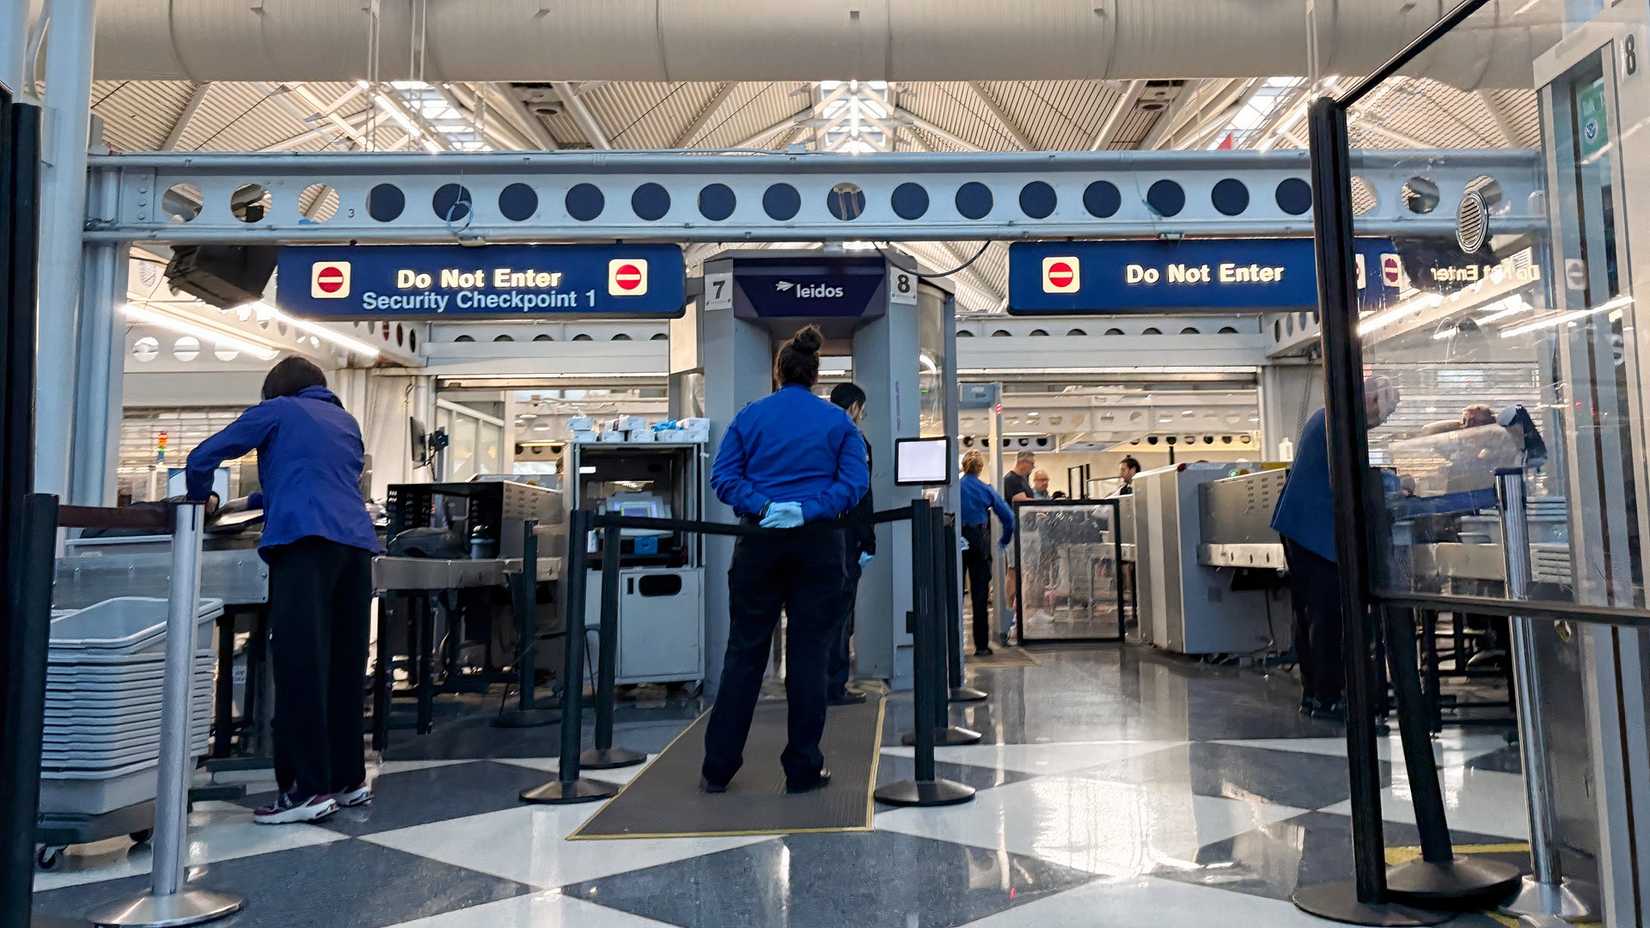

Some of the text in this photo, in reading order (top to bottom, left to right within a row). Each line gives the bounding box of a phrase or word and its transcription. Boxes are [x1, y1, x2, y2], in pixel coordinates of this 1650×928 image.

[1625, 34, 1636, 75] 8
[348, 208, 354, 218] 3
[398, 268, 561, 289] Do Not Enter
[1126, 263, 1284, 283] Do Not Enter
[713, 281, 726, 299] 7
[797, 284, 844, 298] leidos
[897, 274, 910, 293] 8
[363, 289, 596, 312] Security Checkpoint 1
